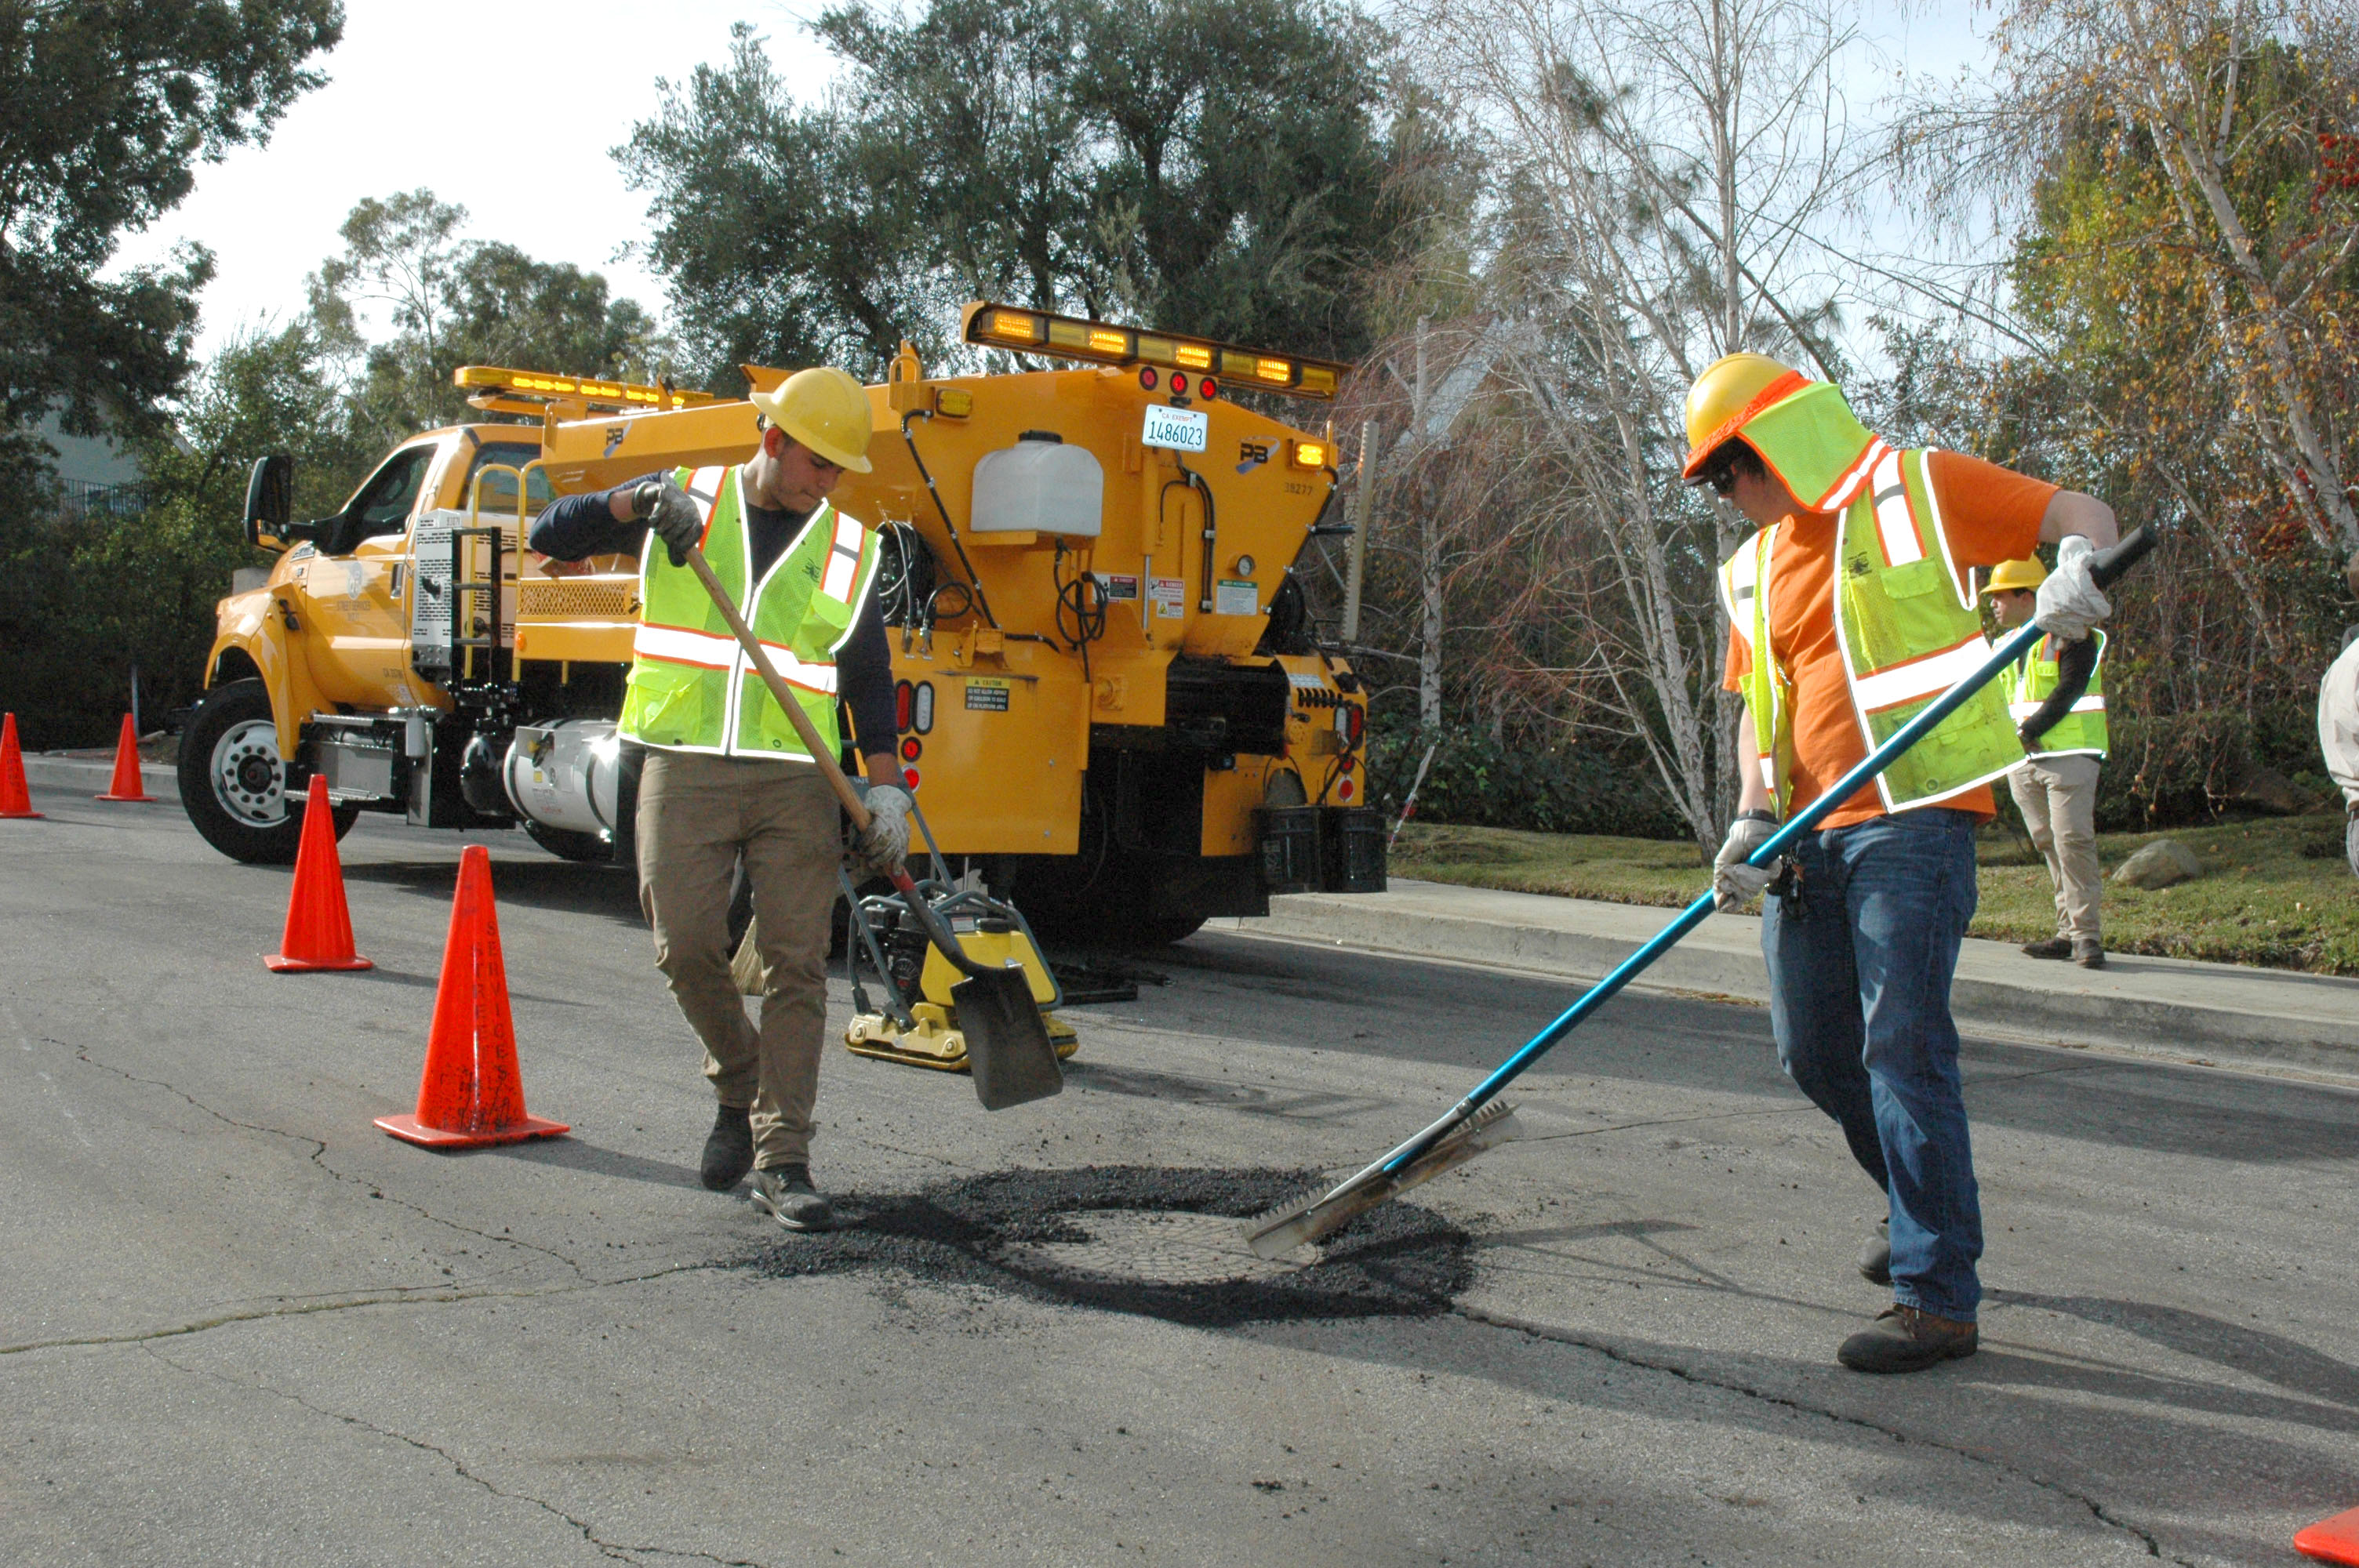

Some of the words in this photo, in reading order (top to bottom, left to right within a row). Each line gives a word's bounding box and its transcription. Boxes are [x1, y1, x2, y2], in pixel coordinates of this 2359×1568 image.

[1172, 414, 1193, 423] EXEMPT
[606, 428, 623, 445] PB
[1148, 421, 1202, 446] 1486023
[1240, 442, 1269, 464] PB
